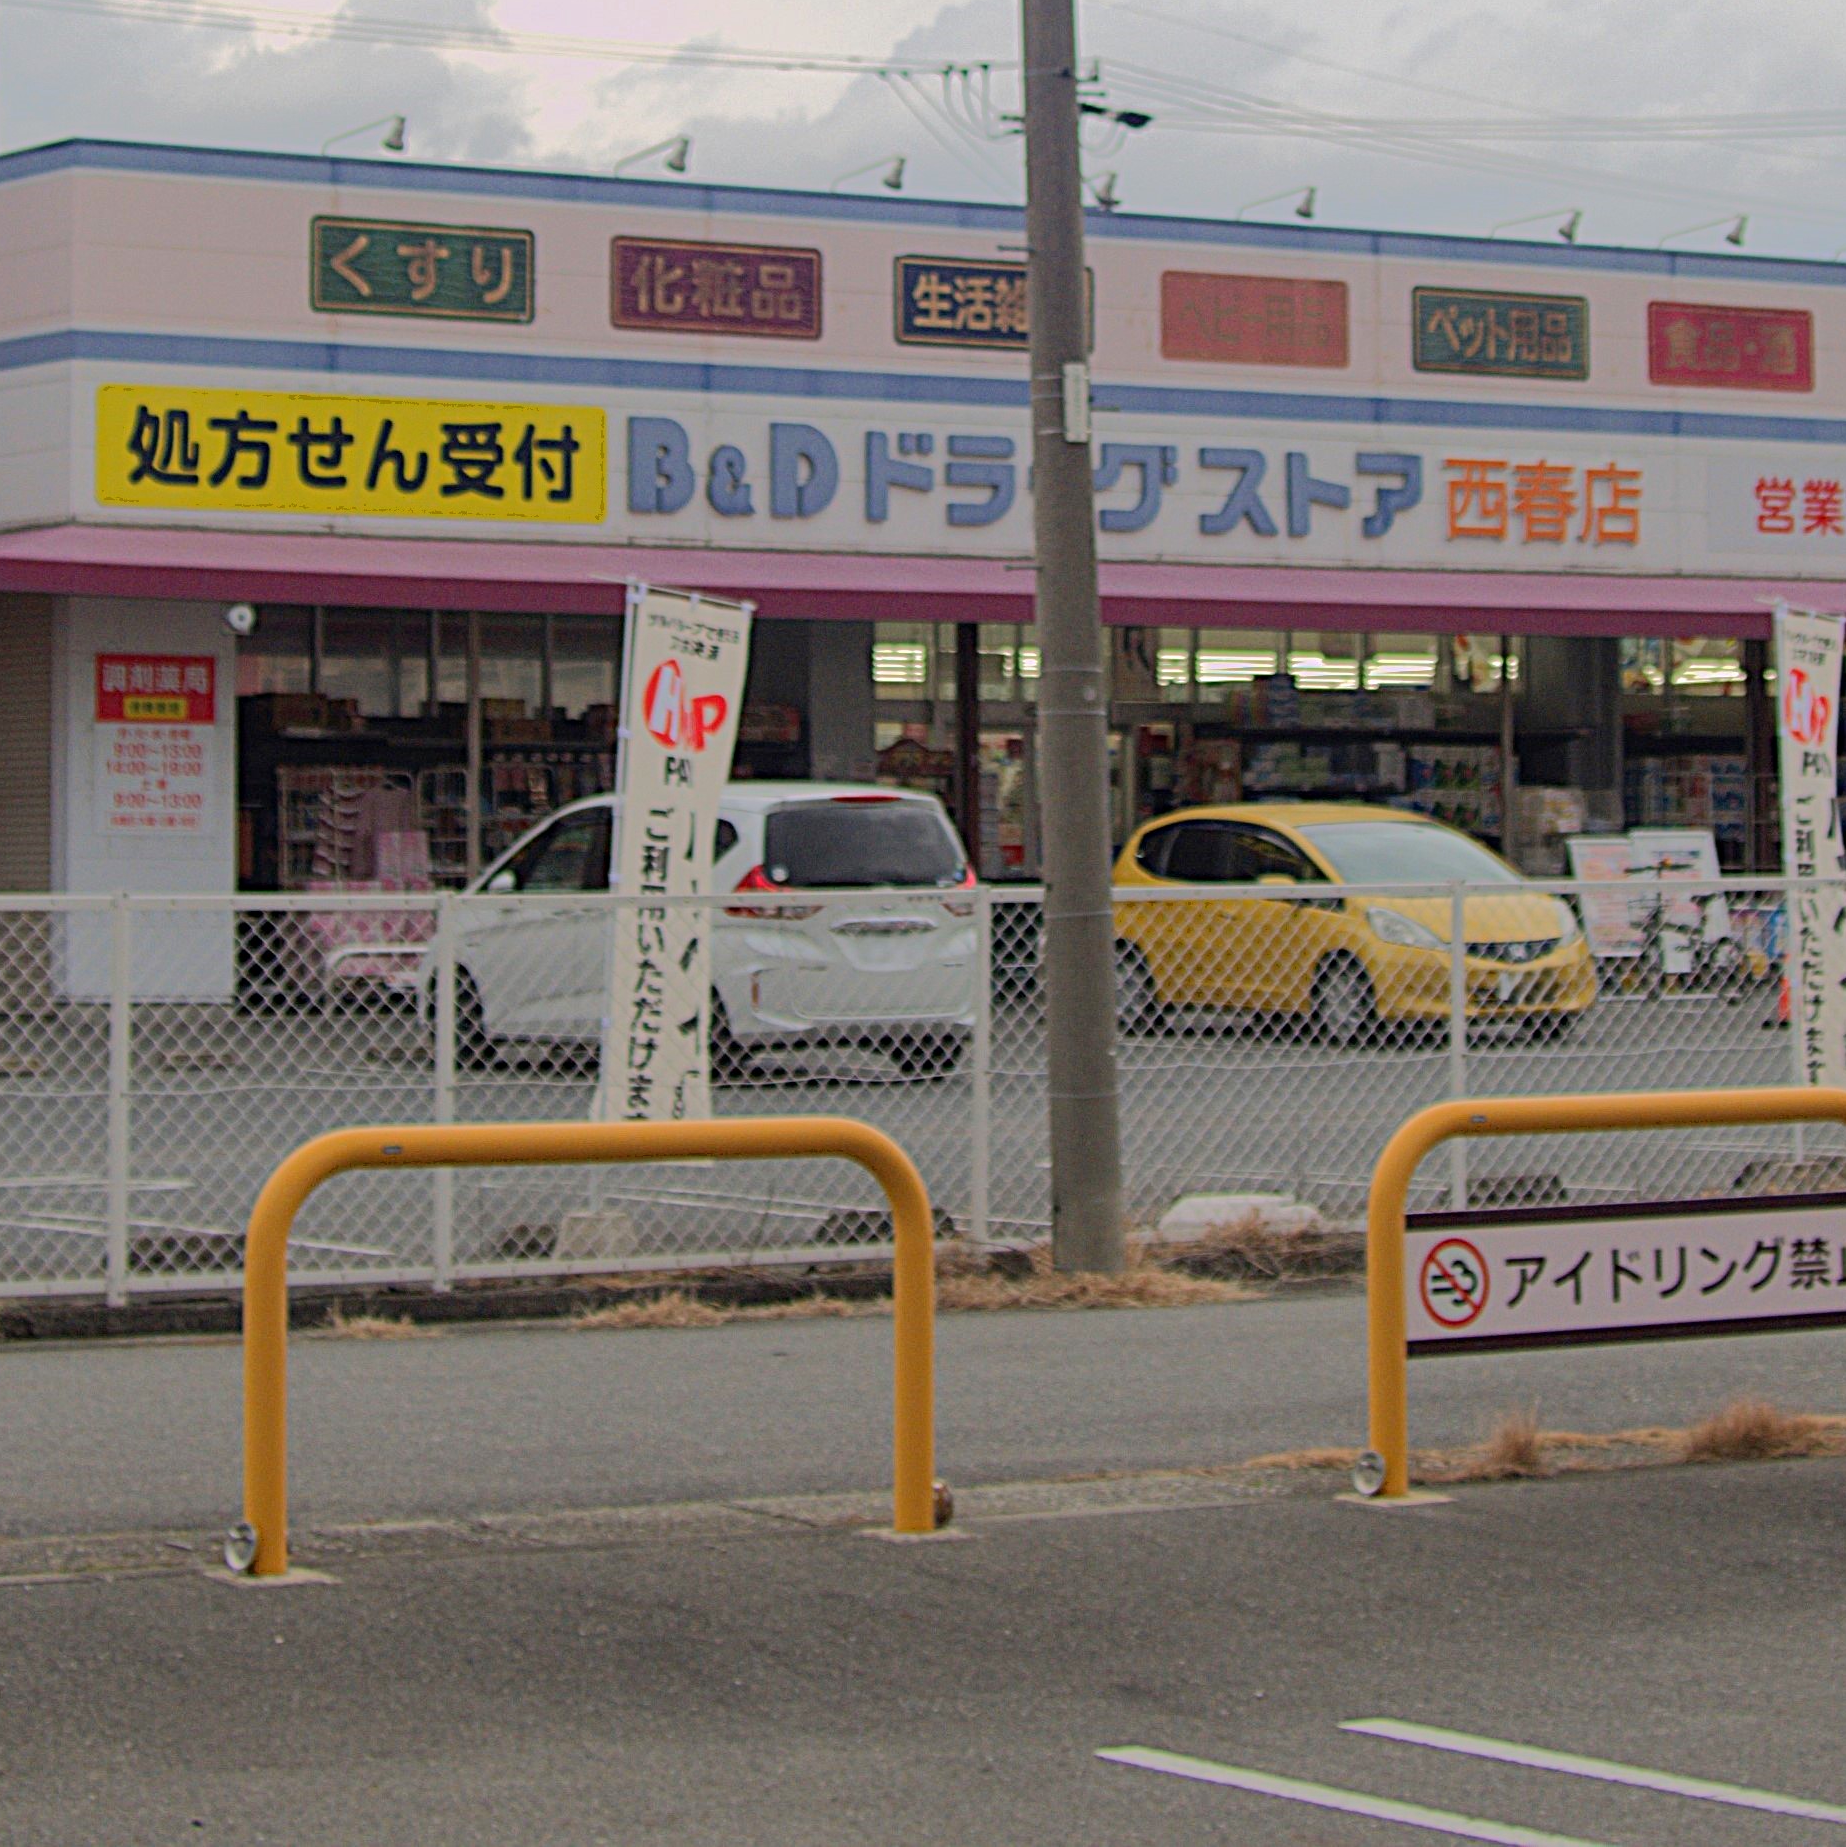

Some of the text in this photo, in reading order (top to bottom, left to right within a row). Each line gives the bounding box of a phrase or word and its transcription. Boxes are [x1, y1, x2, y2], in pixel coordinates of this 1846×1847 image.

[329, 235, 513, 304] くすり
[631, 257, 803, 322] 化粧品
[912, 273, 1030, 334] 生活雑
[1179, 291, 1332, 347] ベビー用品
[1426, 305, 1569, 369] ペット用品
[128, 406, 580, 502] 処方せん受付
[626, 415, 1643, 546] B&D ドラグストア 西春店
